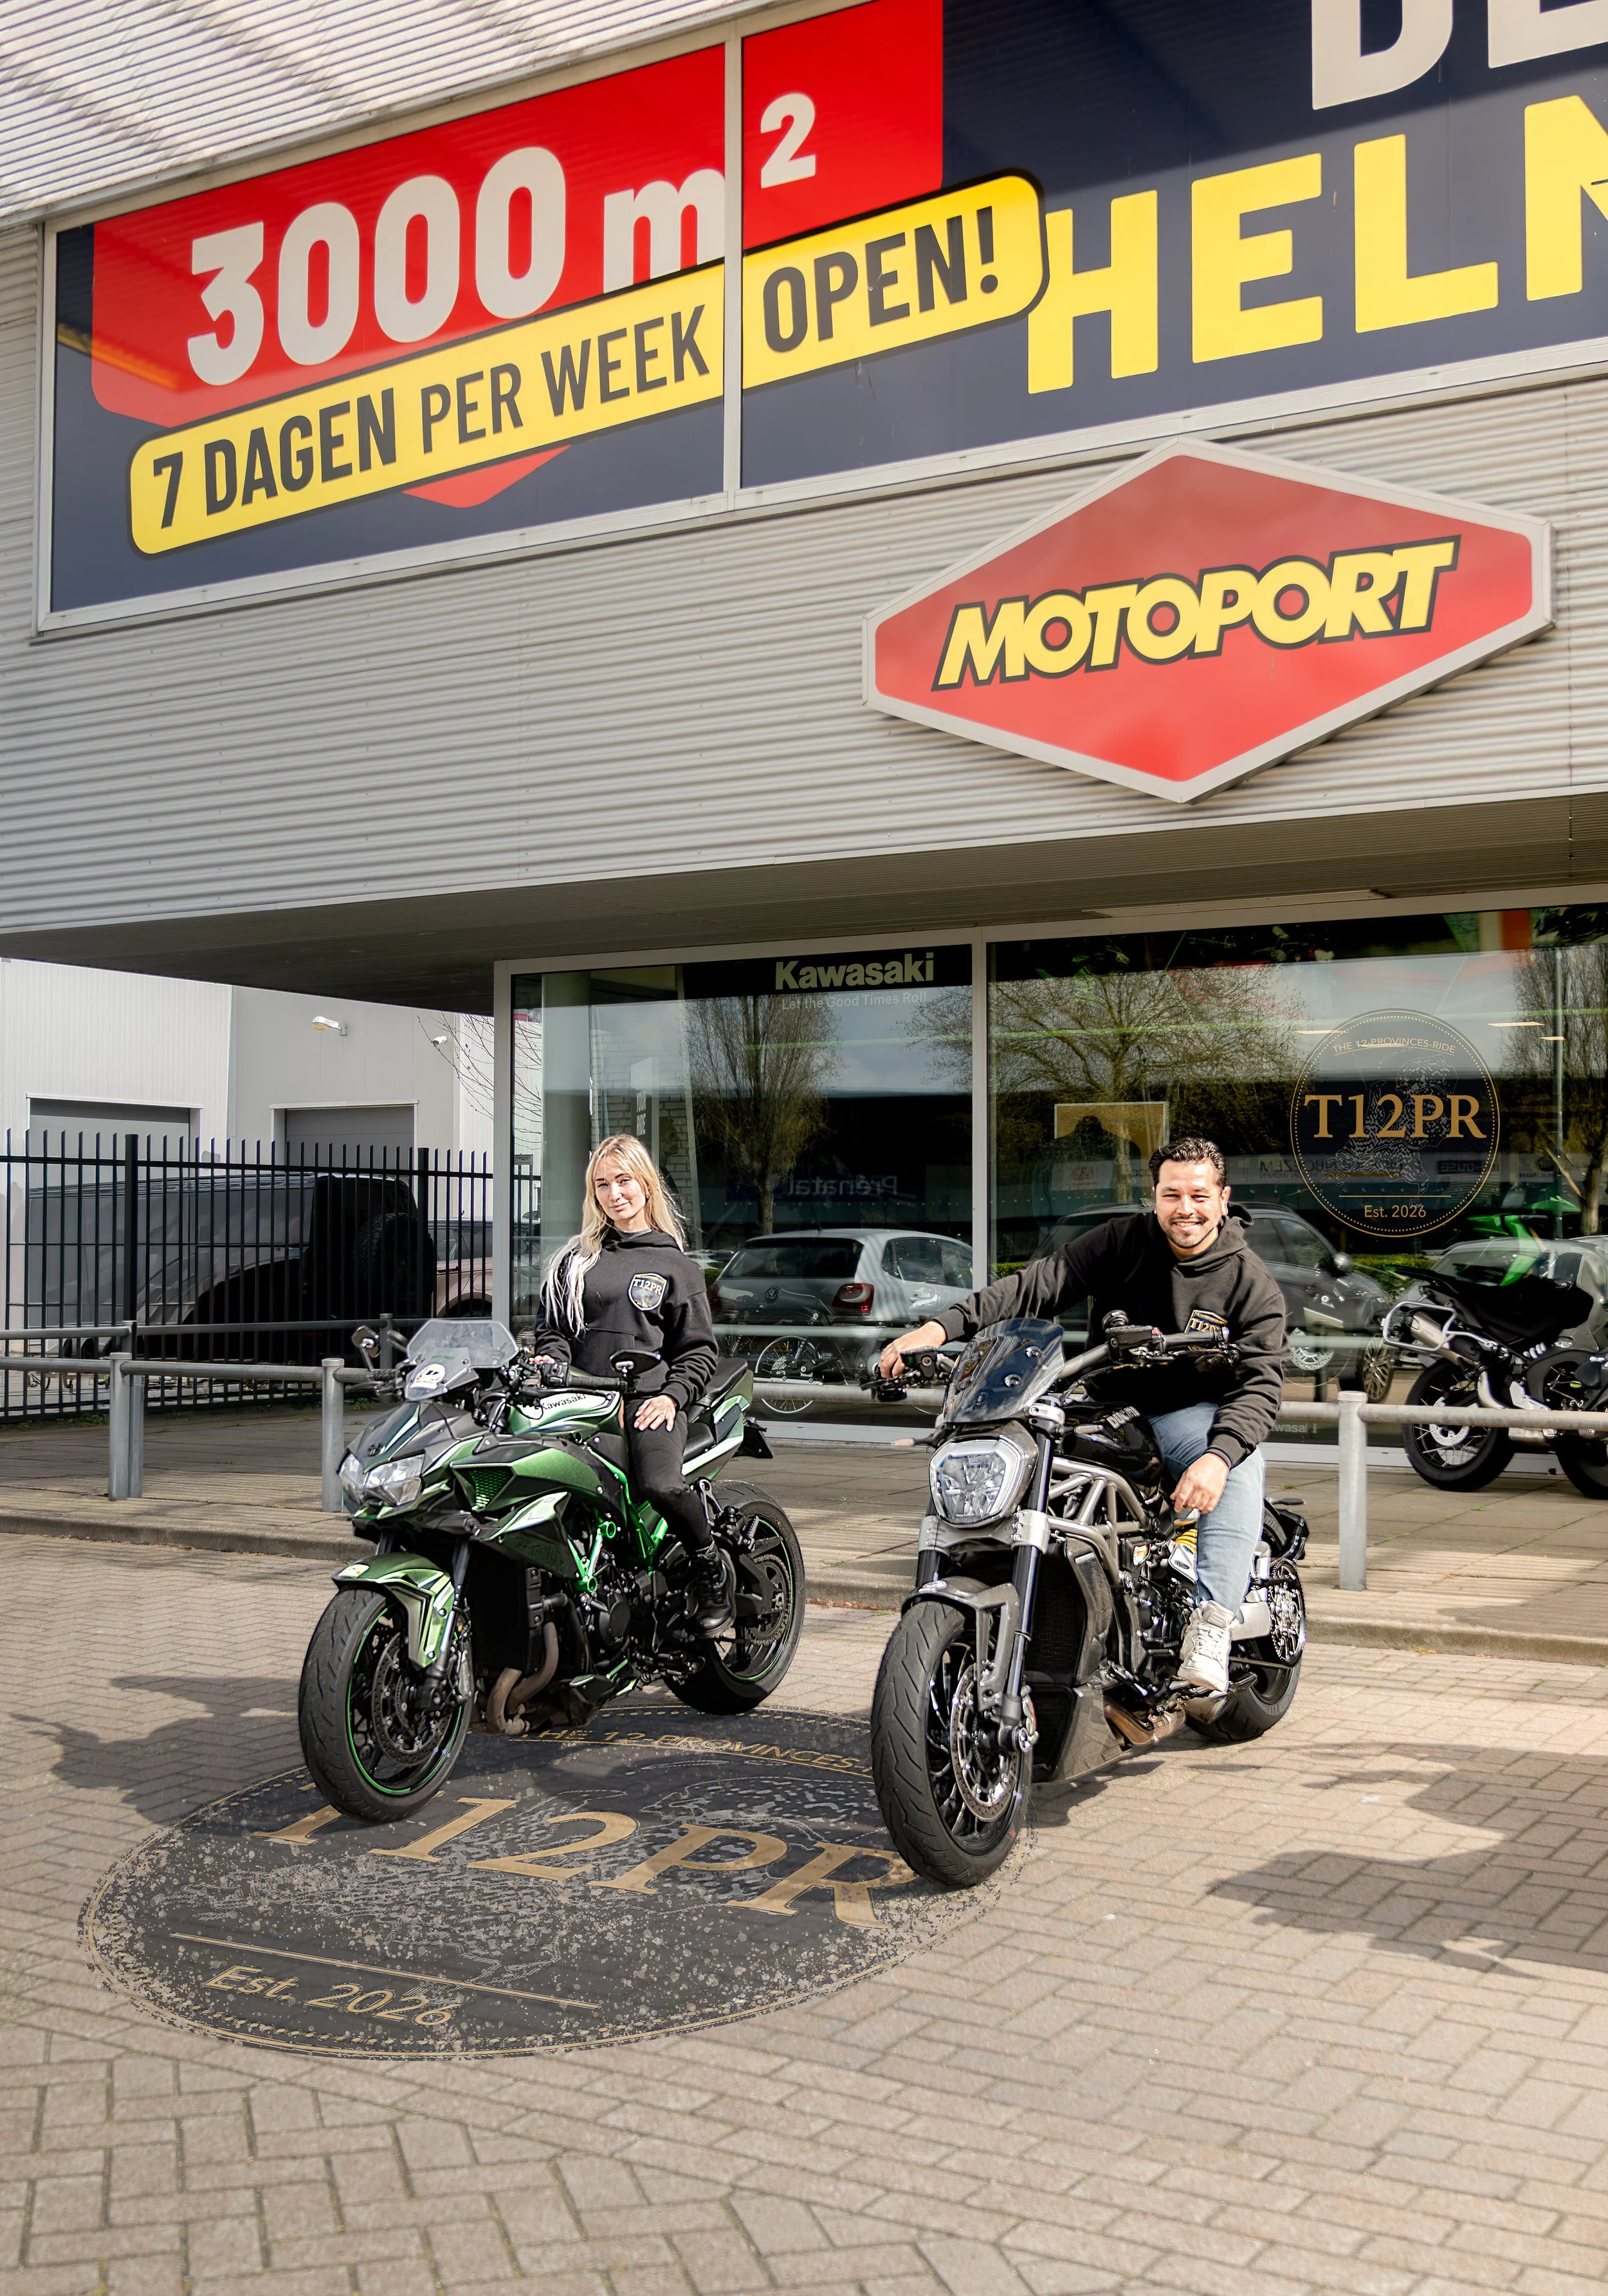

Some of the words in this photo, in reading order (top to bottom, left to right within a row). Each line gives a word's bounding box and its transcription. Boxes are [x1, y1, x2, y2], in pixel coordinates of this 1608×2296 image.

[187, 147, 567, 386] 3000
[153, 451, 184, 529] 7
[204, 387, 396, 516] DAGEN
[421, 363, 523, 454] PER
[541, 304, 710, 417] WEEK
[763, 206, 998, 353] OPEN!
[932, 535, 1461, 692] MOTOPORT
[775, 952, 934, 990] Kawasaki
[781, 998, 801, 1010] Let
[804, 997, 823, 1009] the
[826, 994, 859, 1007] Good
[863, 993, 899, 1006] Times
[902, 991, 926, 1003] Roll
[1332, 1042, 1353, 1053] THE
[1355, 1037, 1456, 1054] 12-PROVINCES-RIDE
[1304, 1094, 1487, 1139] T12PR
[1364, 1206, 1387, 1218] Est.
[1392, 1205, 1427, 1218] 2026
[633, 1279, 662, 1295] T12PR
[1106, 1406, 1140, 1429] DUCATI
[203, 1964, 300, 2000] Est.
[306, 1983, 462, 2026] 2026
